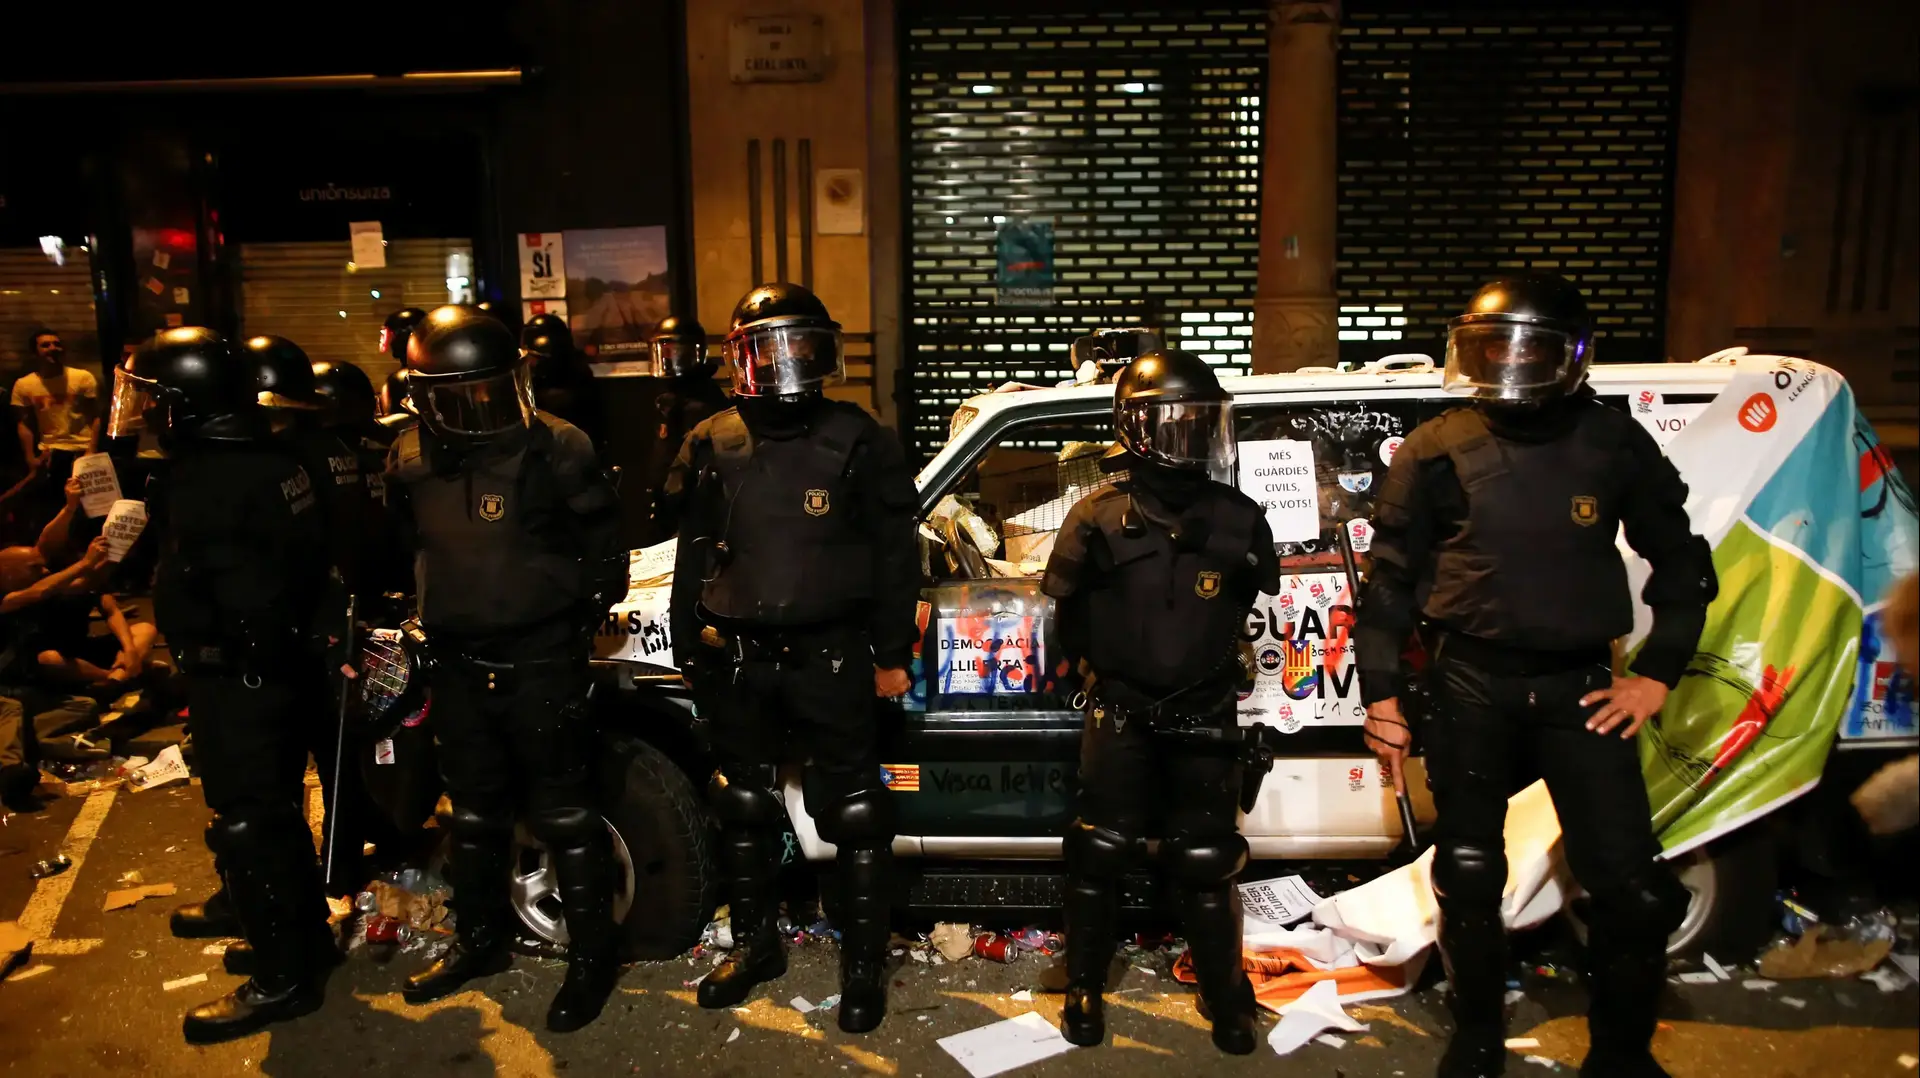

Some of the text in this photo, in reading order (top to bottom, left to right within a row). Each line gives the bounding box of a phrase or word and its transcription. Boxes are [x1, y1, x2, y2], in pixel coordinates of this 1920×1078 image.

[1268, 450, 1292, 460] MÉS
[1254, 465, 1309, 477] GUÀRDIES
[1265, 483, 1301, 493] CIVILS,
[1280, 499, 1312, 509] VOTS!
[1239, 605, 1357, 642] GUAR
